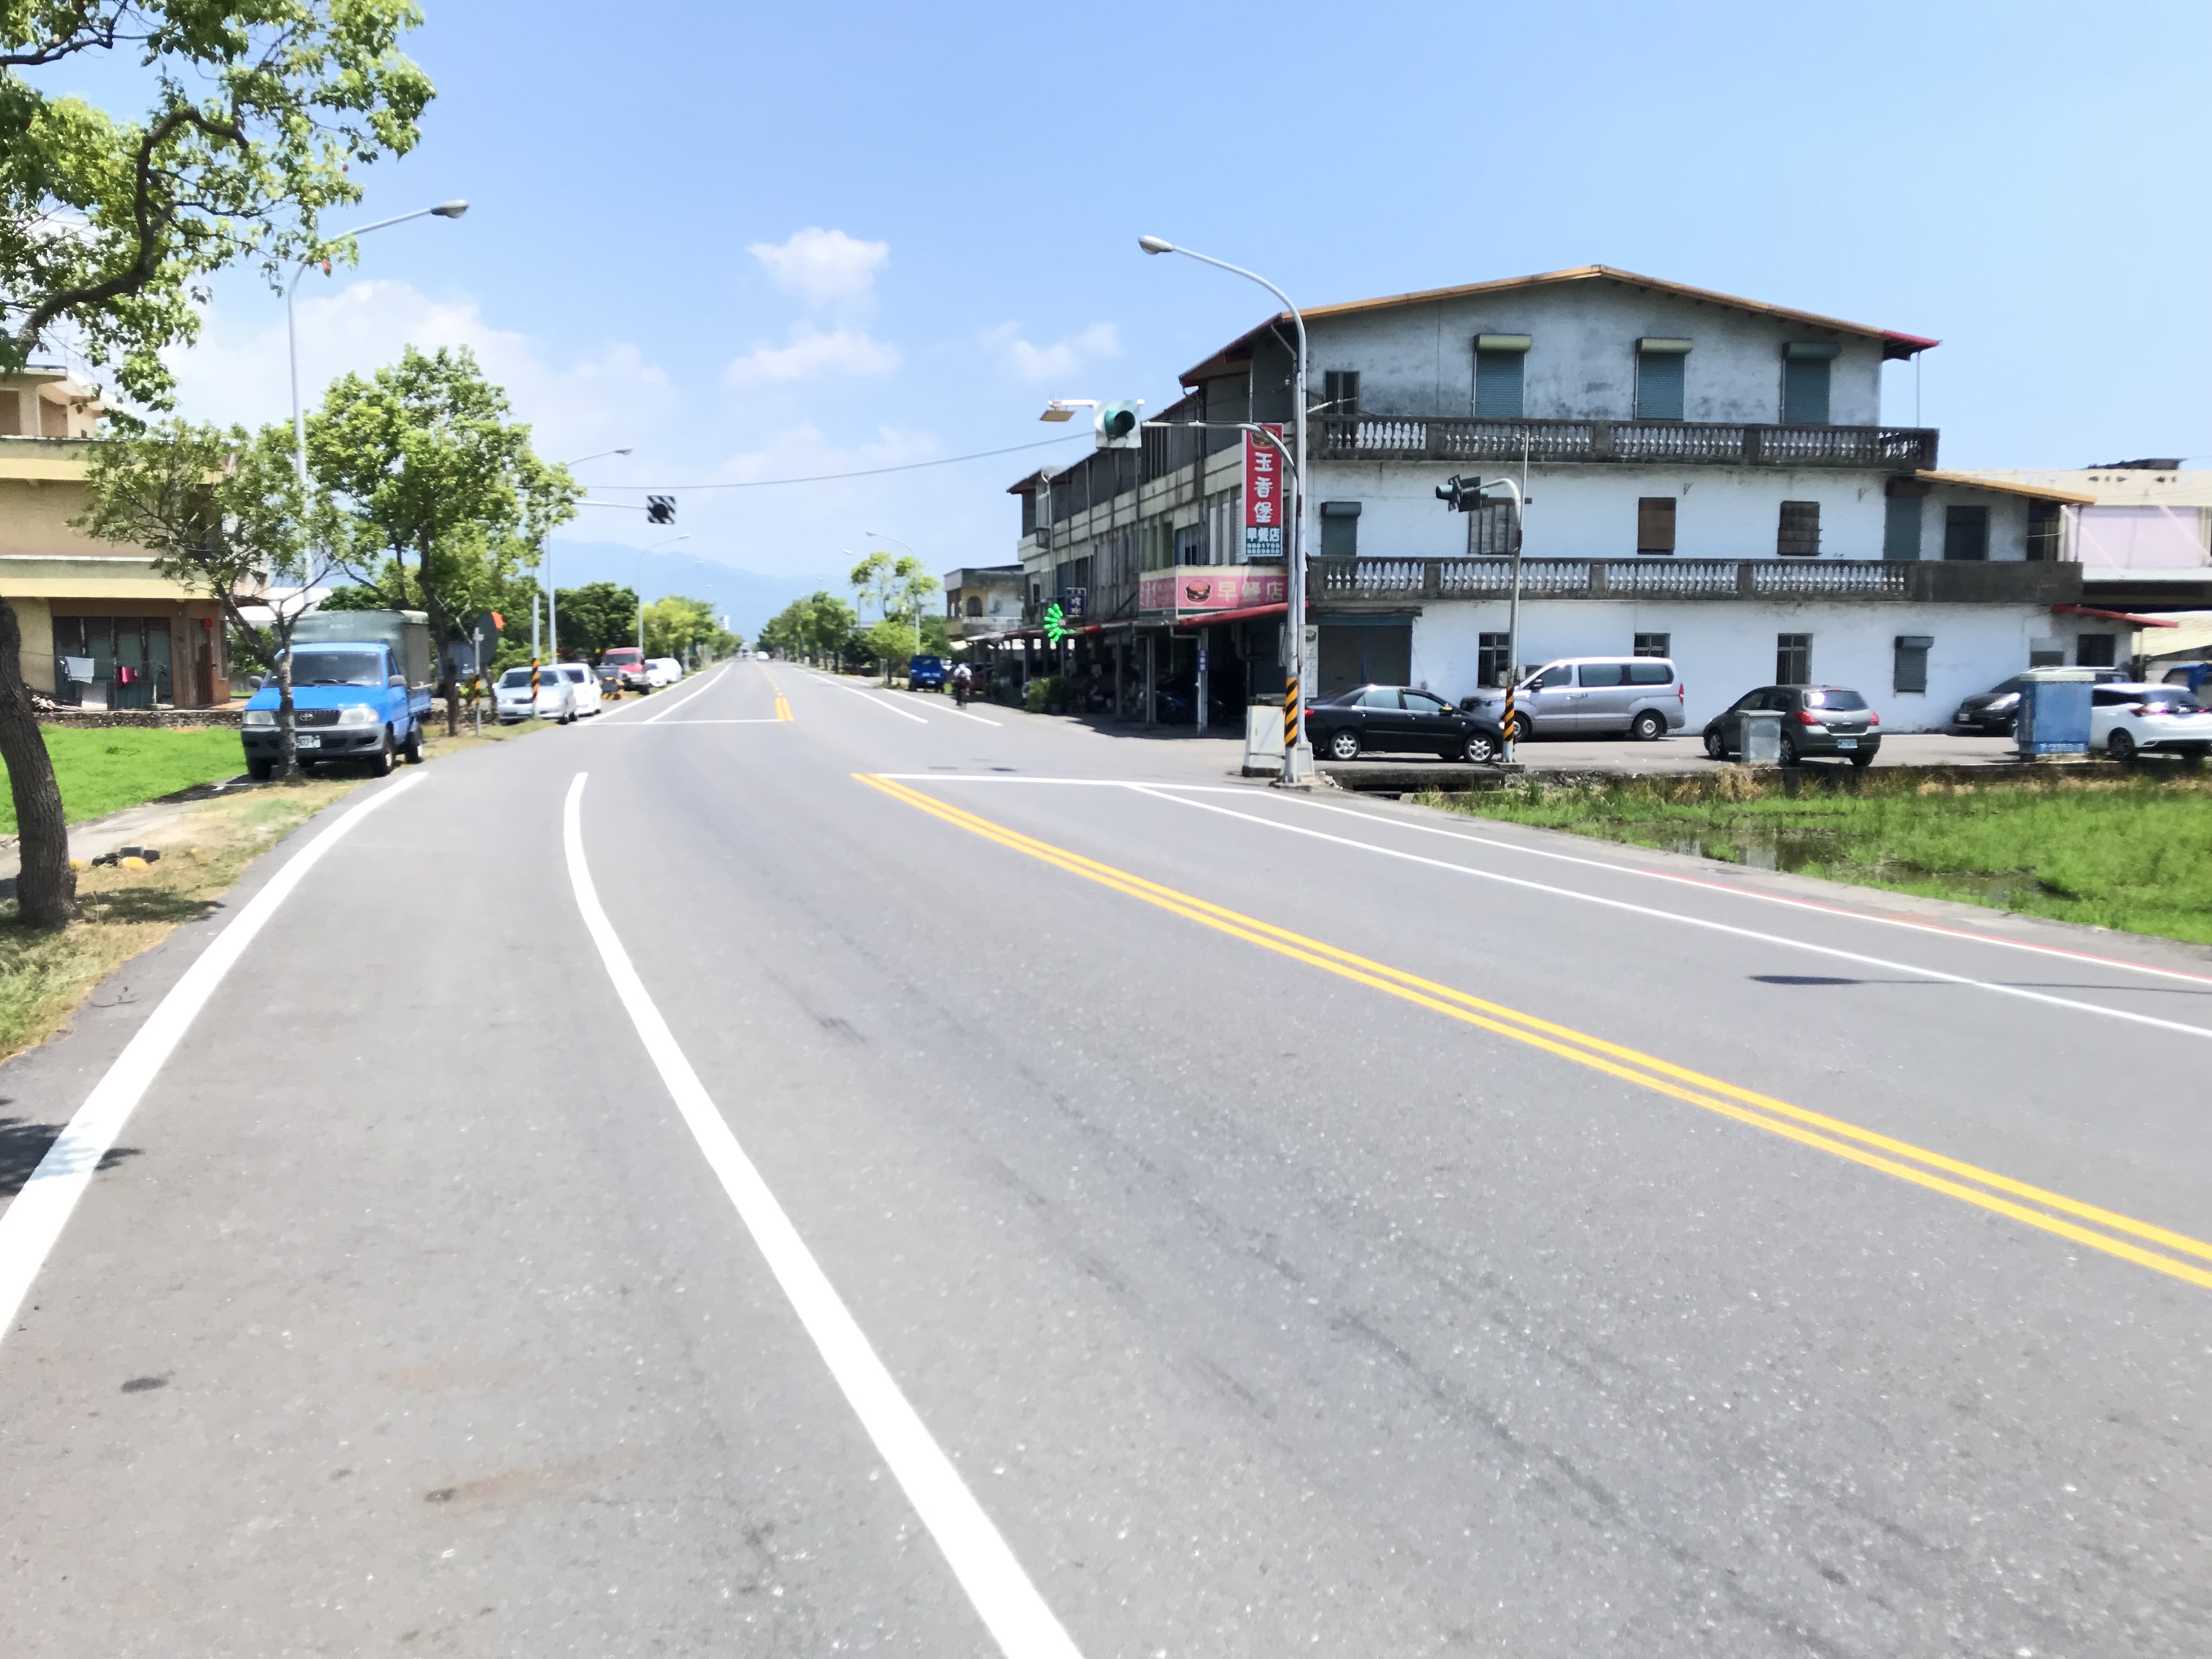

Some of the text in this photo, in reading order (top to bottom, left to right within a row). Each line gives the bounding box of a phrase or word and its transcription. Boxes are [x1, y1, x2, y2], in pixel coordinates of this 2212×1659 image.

[1254, 452, 1273, 523] 玉香堡
[1247, 527, 1280, 542] 早餐店
[1217, 580, 1284, 602] 早餐店
